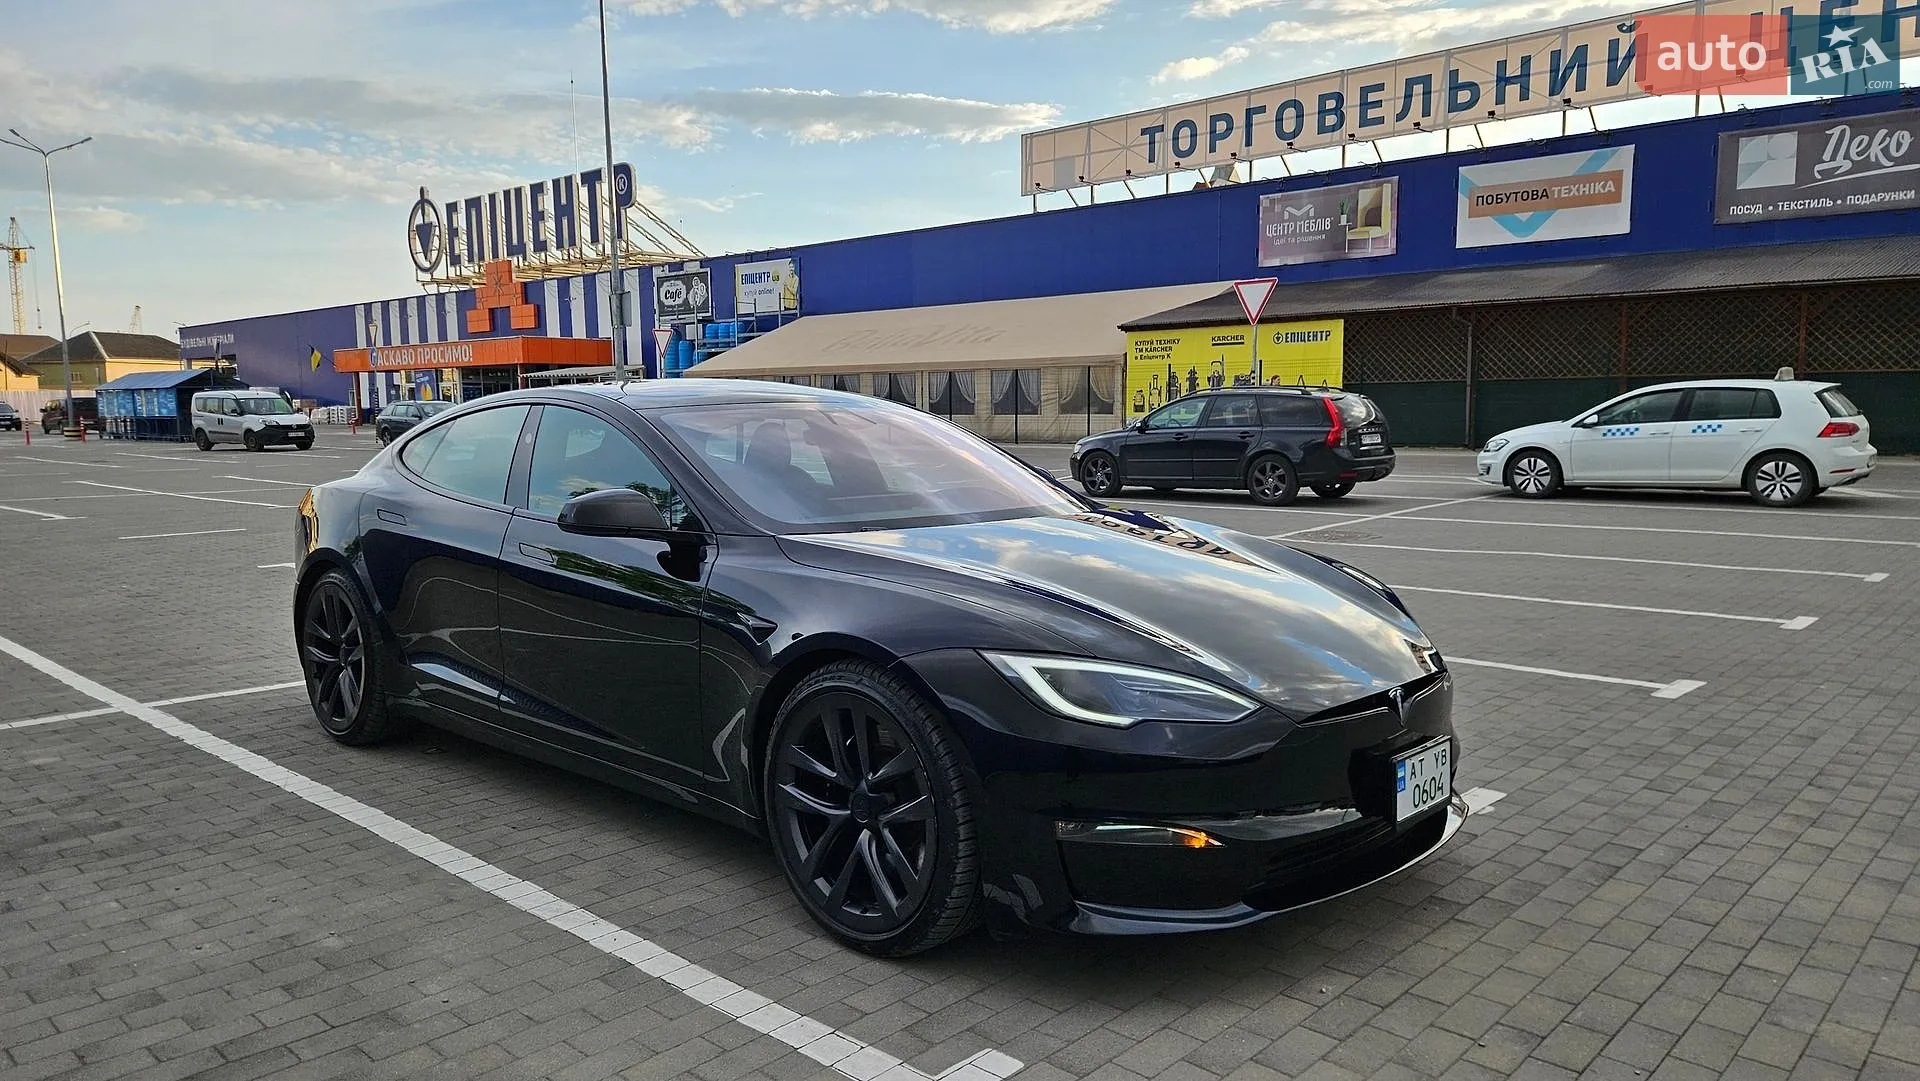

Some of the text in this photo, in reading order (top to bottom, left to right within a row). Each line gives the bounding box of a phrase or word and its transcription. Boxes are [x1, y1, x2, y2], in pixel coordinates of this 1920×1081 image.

[1141, 20, 1648, 163] ТОРГОВЕЛЬНИЙ
[1814, 124, 1914, 179] Деко
[1475, 180, 1616, 207] ПОБУТОВА ТЕХНІКА
[1729, 189, 1916, 216] ПОСУД ТЕКСТИЛЬ ПОДАРУНКИ
[446, 162, 637, 266] ЕПІЦЕНТР
[1266, 217, 1331, 238] ЦЕНТР МЕБЛІВ
[741, 271, 770, 285] ЕПІЦЕНТР
[1285, 330, 1331, 343] ЕПІЦЕНТР
[371, 344, 473, 367] АСКАВО ПРОСИМО!
[1410, 758, 1425, 781] AT
[1433, 748, 1447, 769] YB
[1413, 772, 1444, 809] 0604
